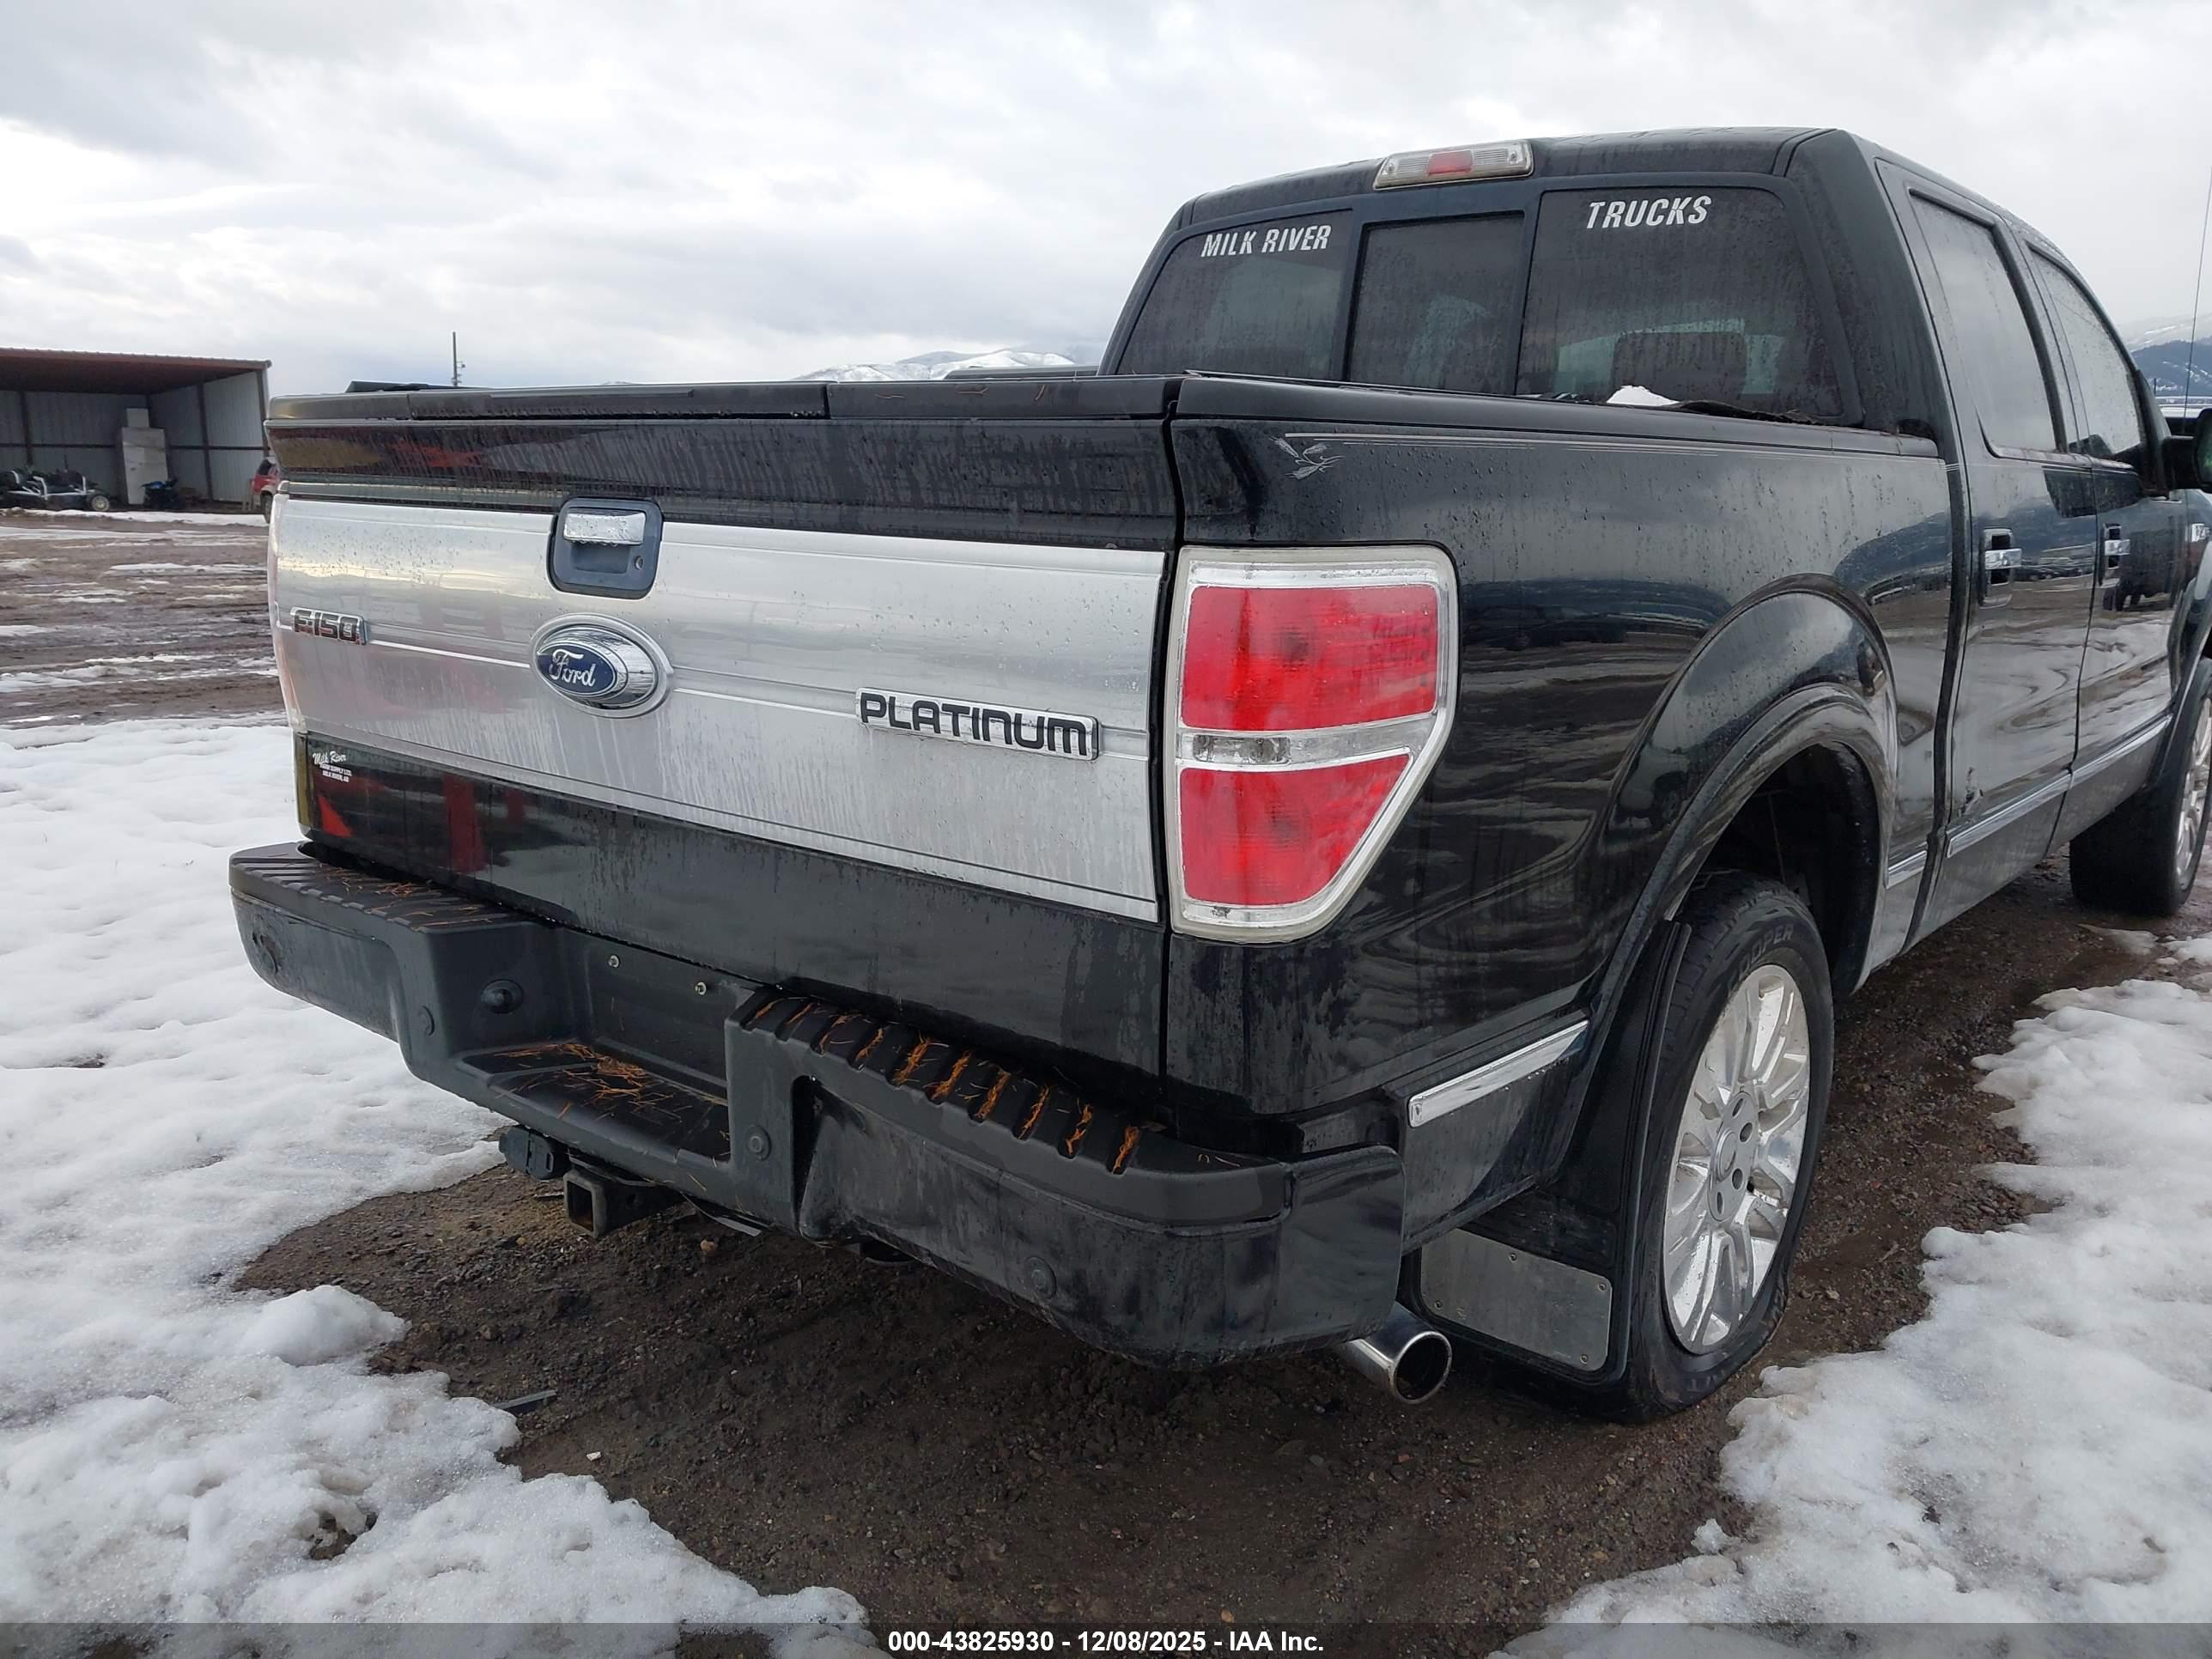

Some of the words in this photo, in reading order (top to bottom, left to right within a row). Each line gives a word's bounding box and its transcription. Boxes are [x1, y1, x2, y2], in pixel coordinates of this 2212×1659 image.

[1200, 231, 1257, 258] MILK
[1261, 225, 1332, 253] RIVER
[1587, 195, 1712, 228] TRUCKS
[548, 648, 597, 687] Ford
[860, 691, 1088, 757] PLATINUM
